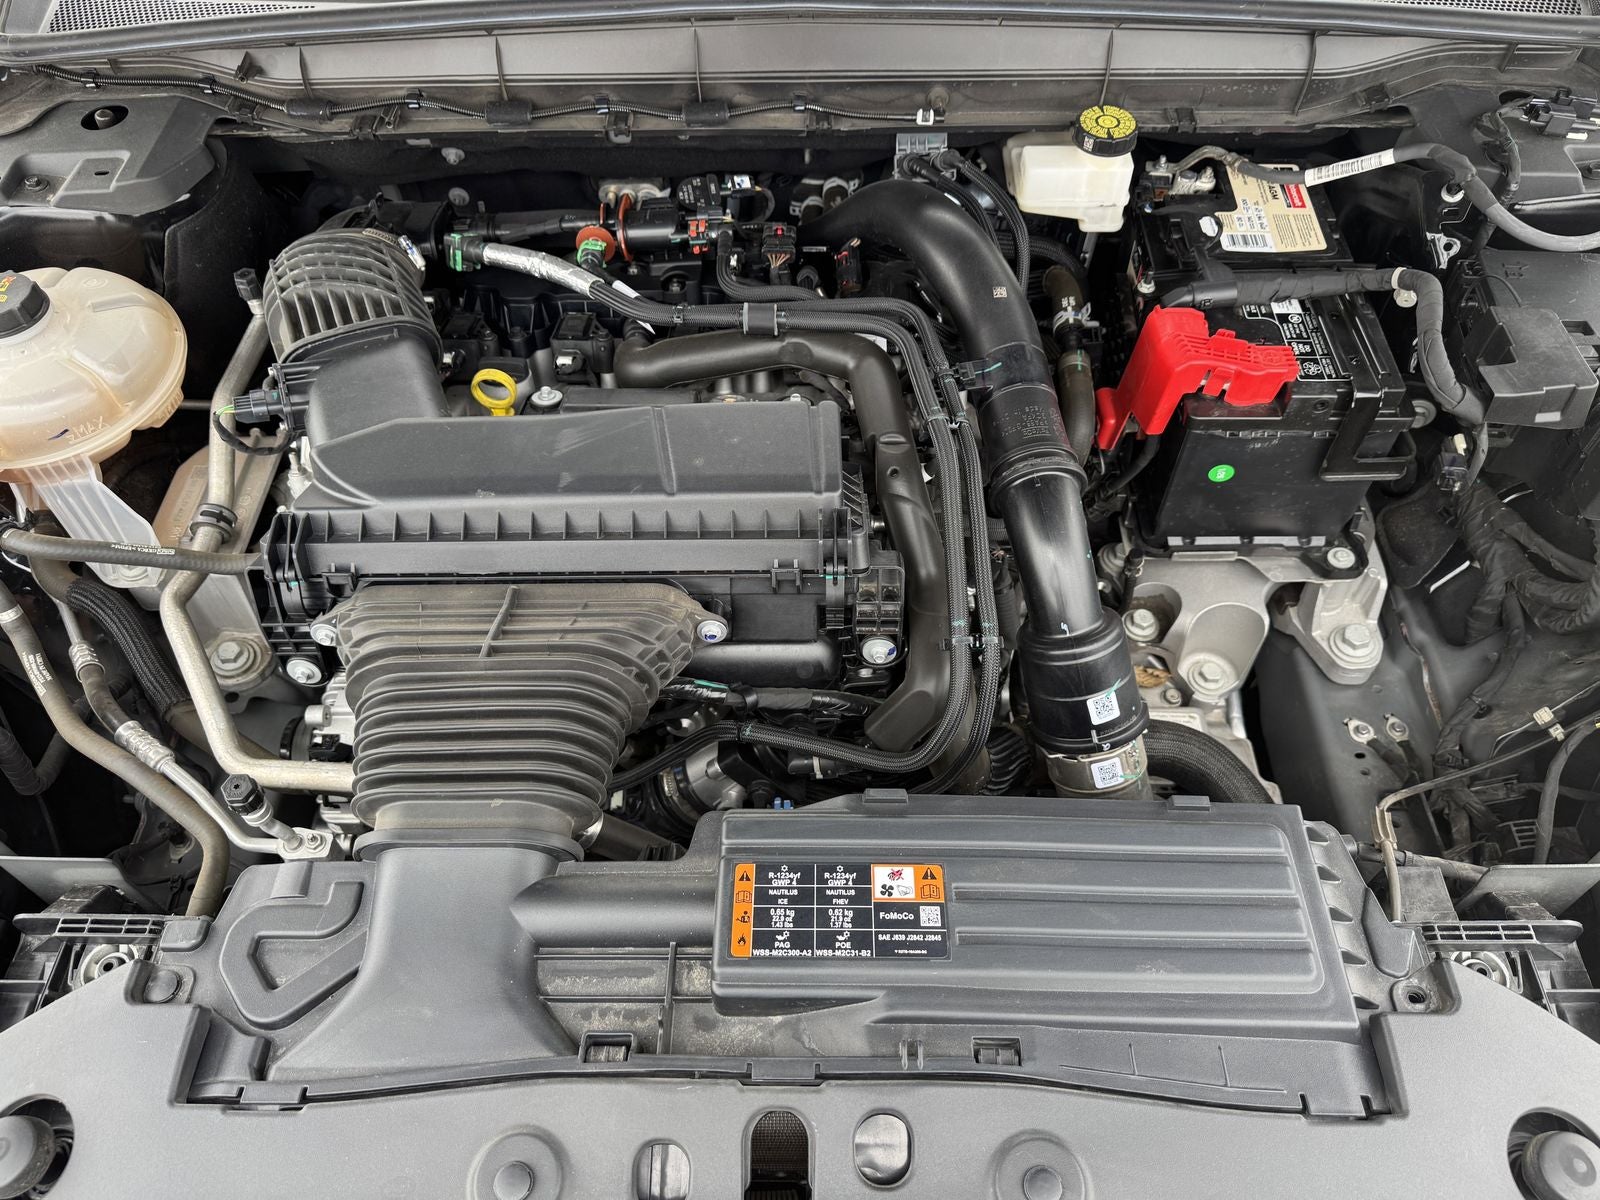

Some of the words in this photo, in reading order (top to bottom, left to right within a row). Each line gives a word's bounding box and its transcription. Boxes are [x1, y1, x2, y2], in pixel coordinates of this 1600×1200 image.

[1268, 185, 1280, 200] AGM
[1290, 184, 1302, 207] otorcraft
[1291, 342, 1300, 355] OPEN
[1304, 344, 1312, 352] DO
[845, 909, 853, 917] kg
[880, 912, 914, 920] FoMoCo
